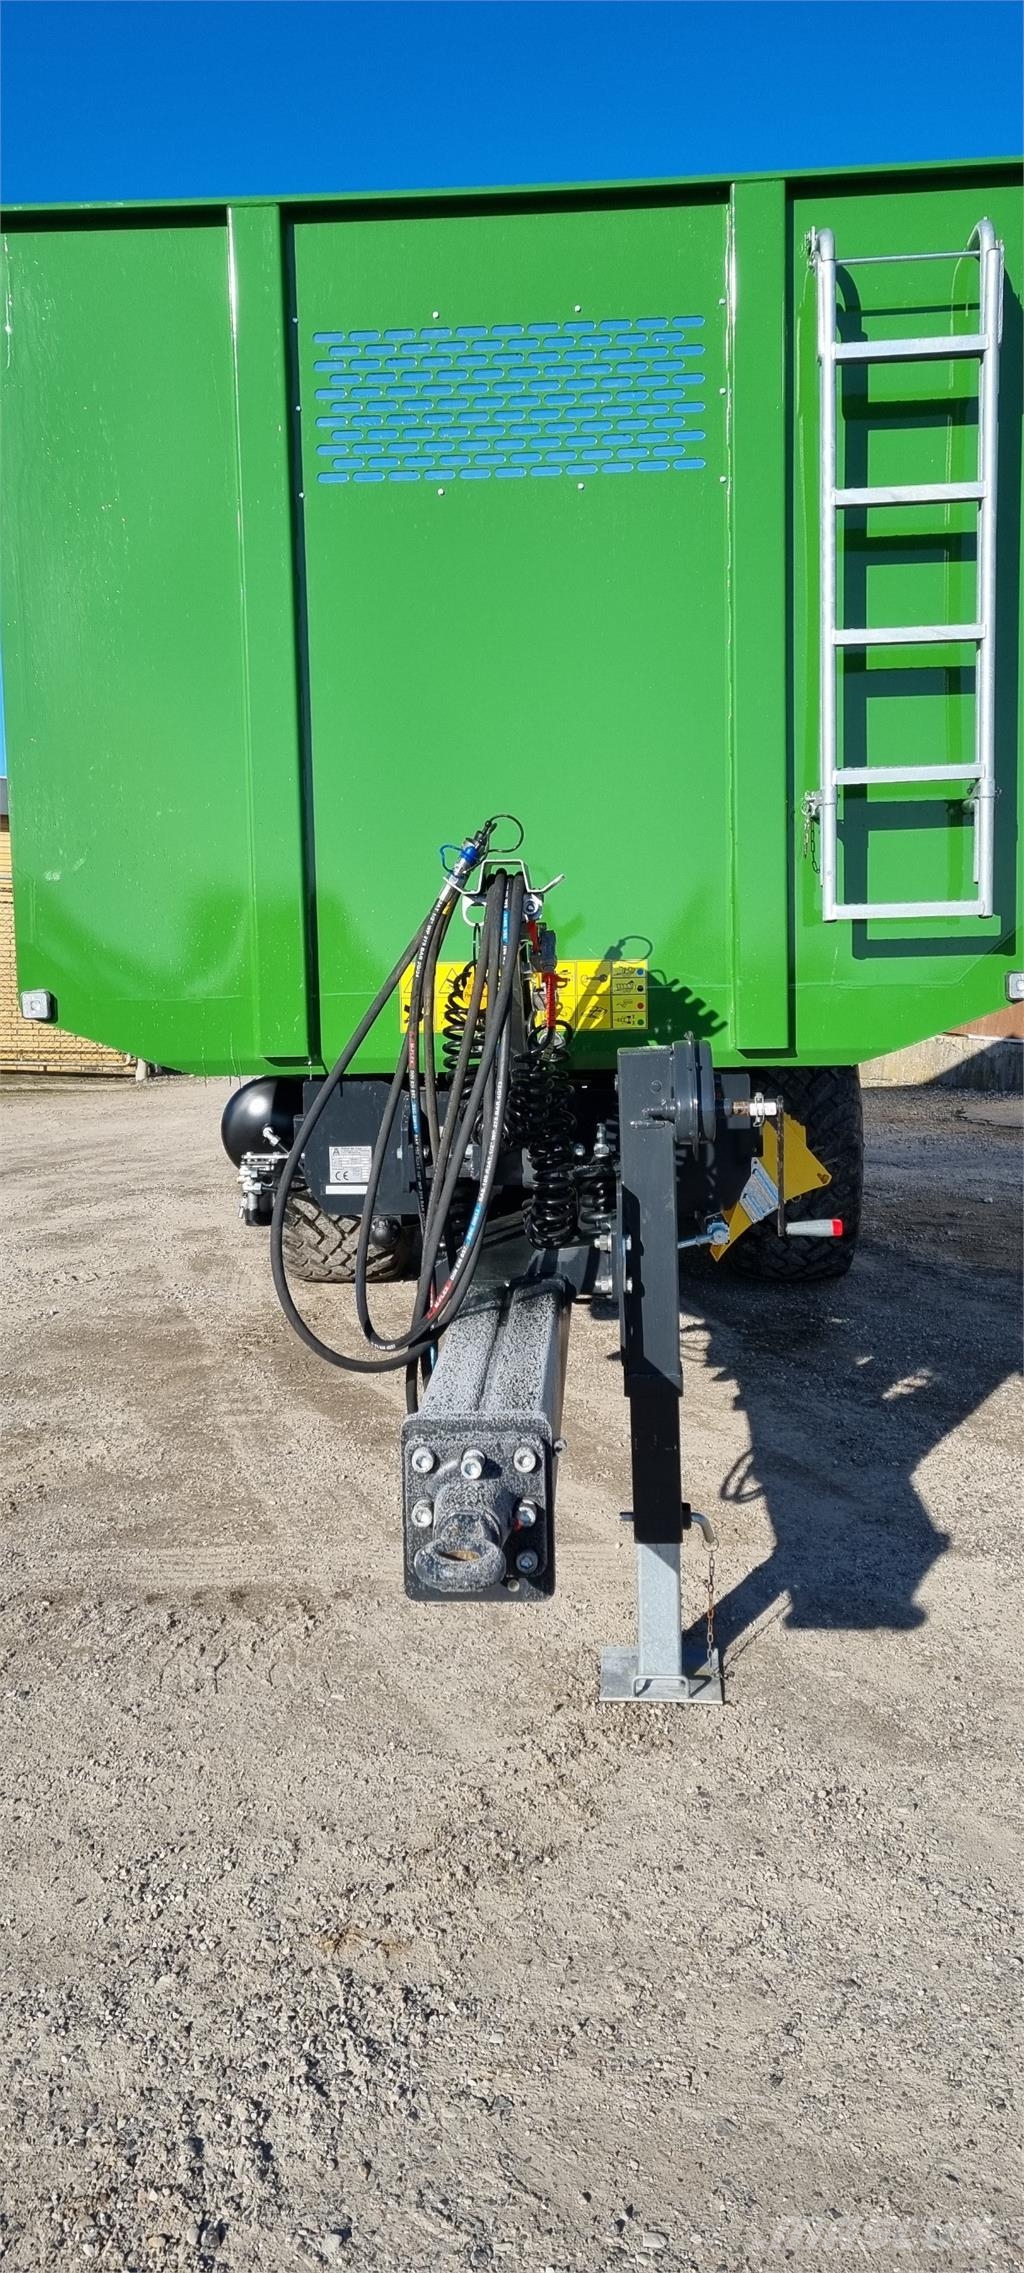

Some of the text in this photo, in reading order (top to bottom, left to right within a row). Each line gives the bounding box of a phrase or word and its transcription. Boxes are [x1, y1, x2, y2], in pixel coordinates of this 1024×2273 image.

[418, 946, 426, 960] BAR
[335, 1171, 349, 1181] CE
[449, 1267, 458, 1281] DIN
